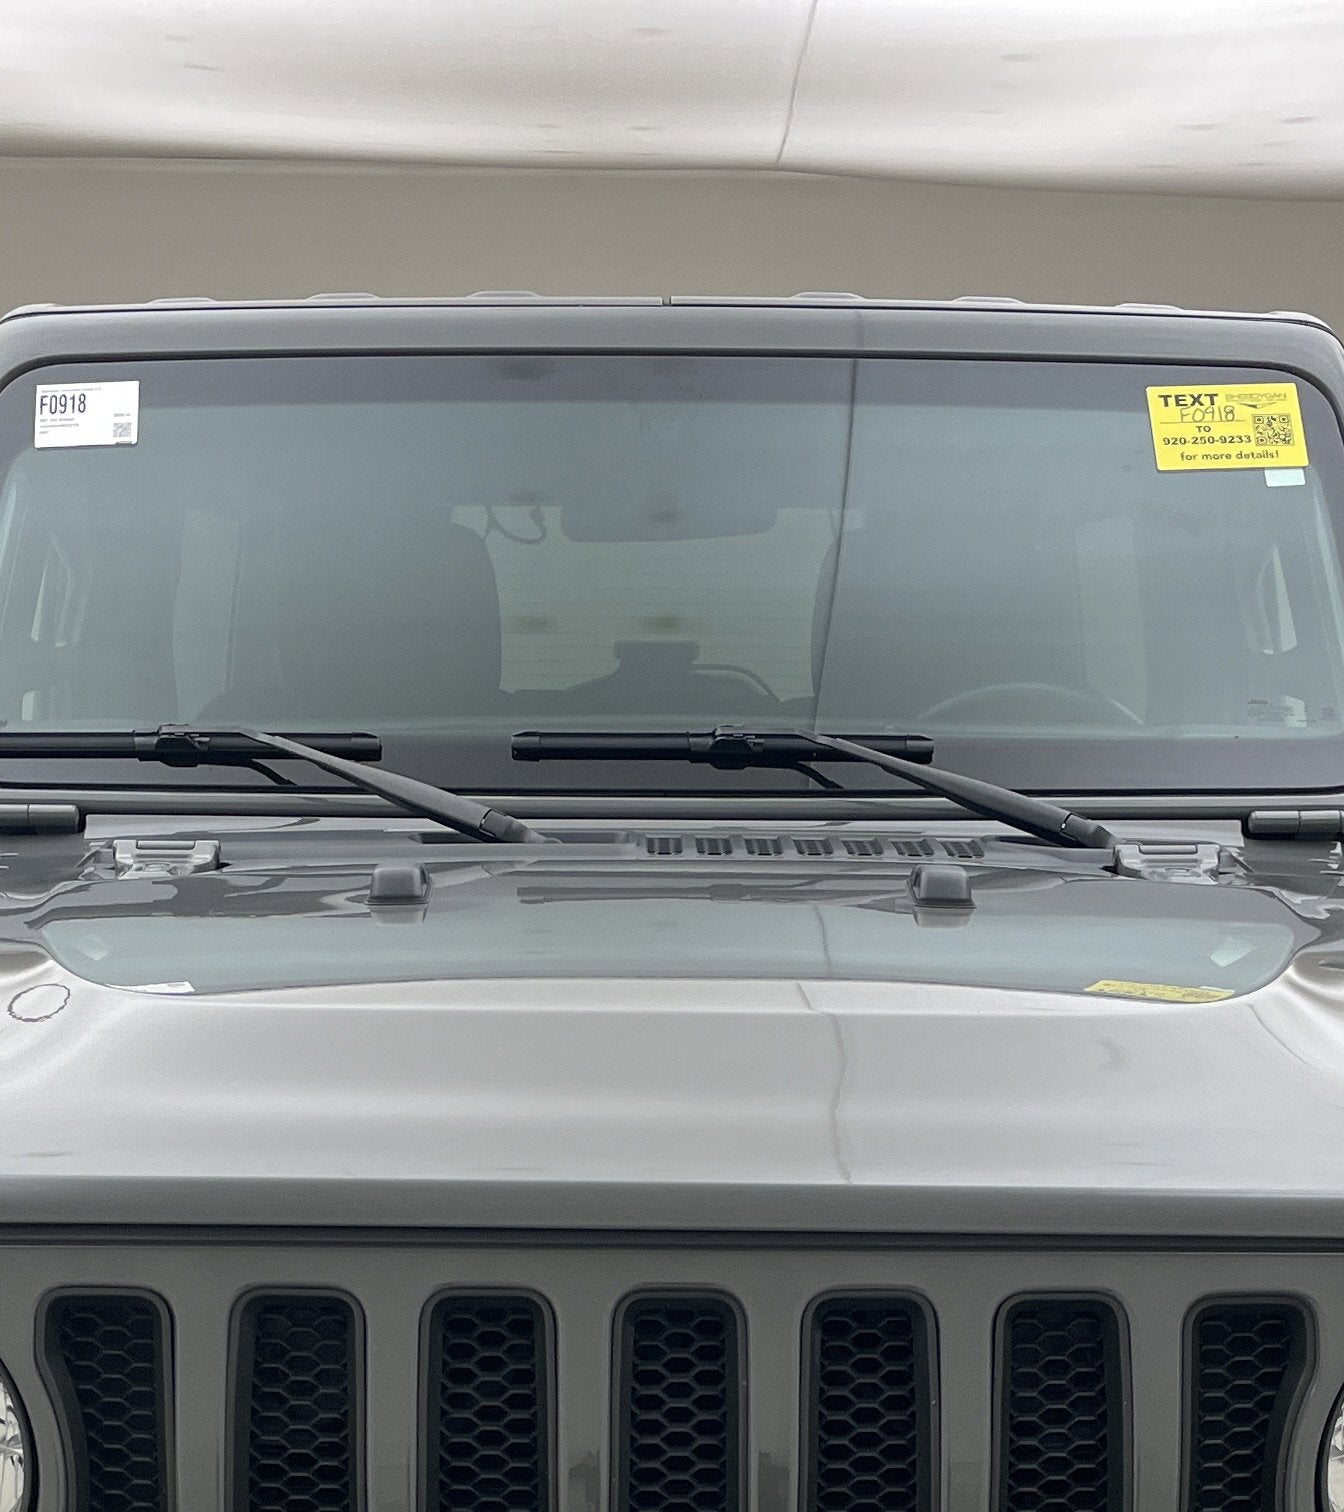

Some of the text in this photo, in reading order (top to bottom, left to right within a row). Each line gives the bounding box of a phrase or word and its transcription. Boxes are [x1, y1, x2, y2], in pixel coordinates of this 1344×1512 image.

[39, 393, 87, 415] F0918
[1158, 393, 1218, 407] TEXT
[1180, 405, 1235, 422] F0918
[1196, 425, 1211, 433] TO
[1162, 434, 1252, 446] 920-250-9233
[1180, 451, 1198, 461] for
[1236, 450, 1279, 460] details!
